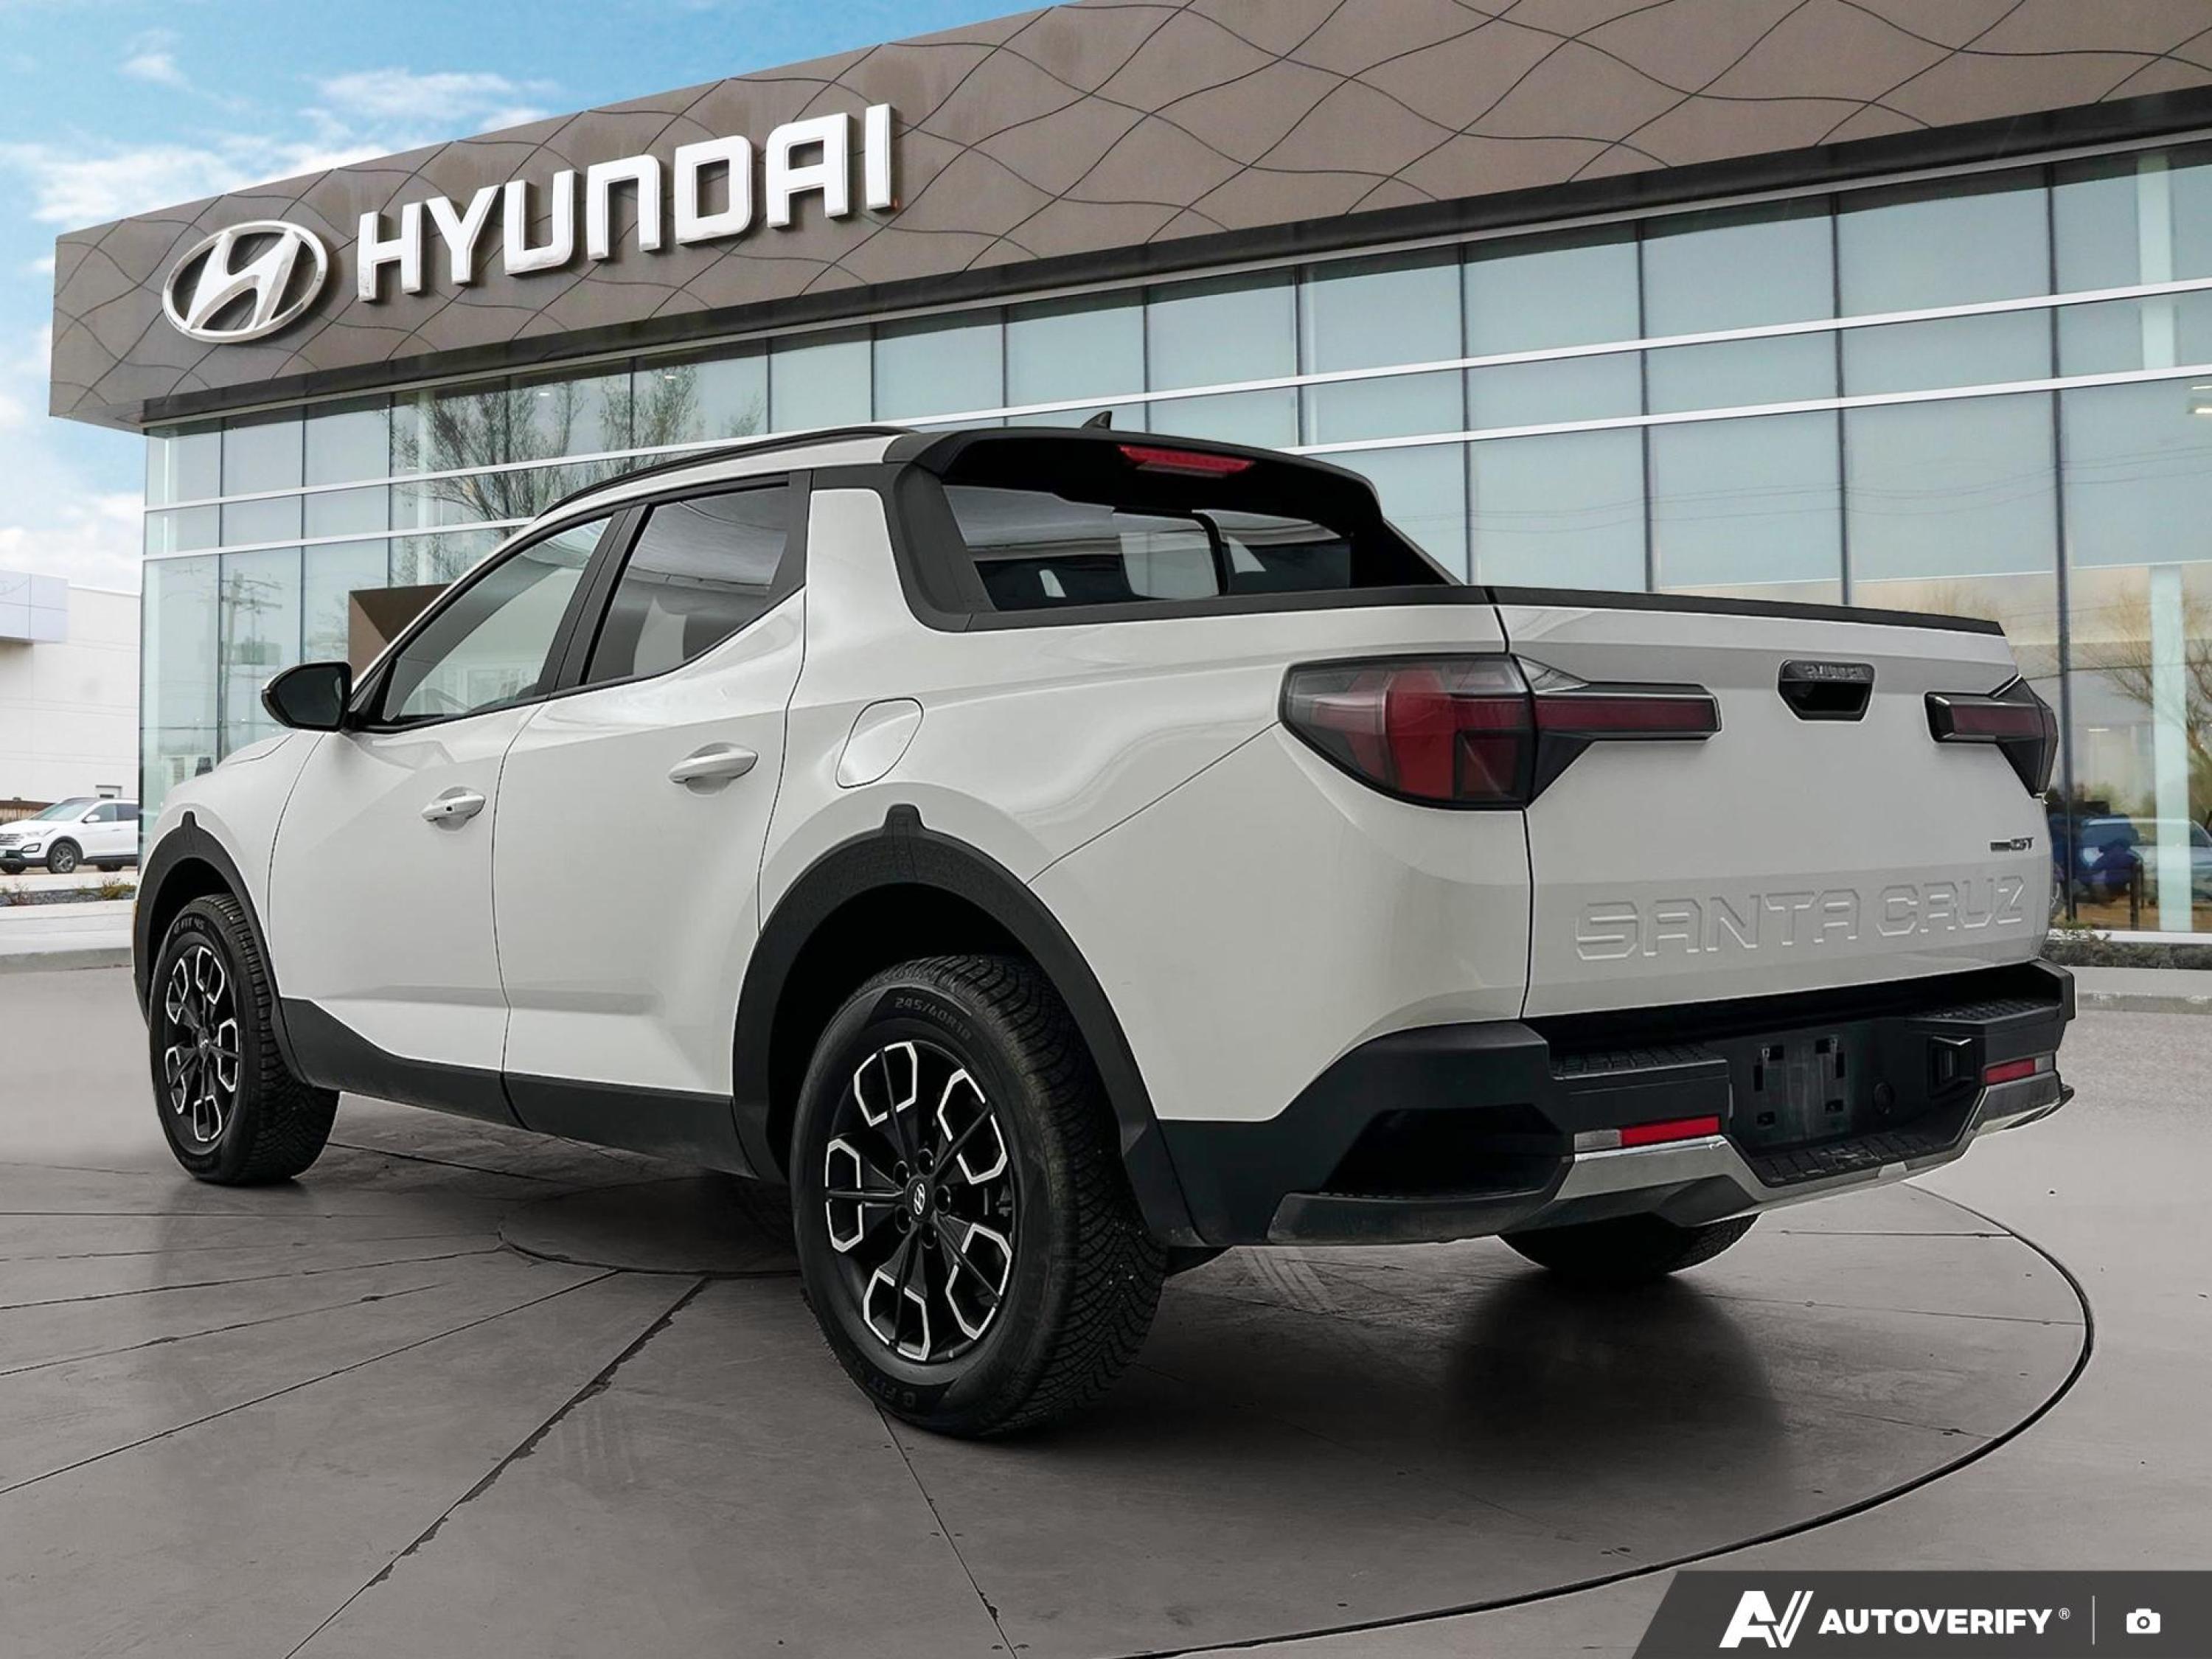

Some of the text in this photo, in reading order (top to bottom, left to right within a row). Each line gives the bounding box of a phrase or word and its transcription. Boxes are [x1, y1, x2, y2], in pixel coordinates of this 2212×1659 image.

[357, 103, 894, 302] HYUNDAI
[1575, 875, 2025, 960] SANTA CRUZ
